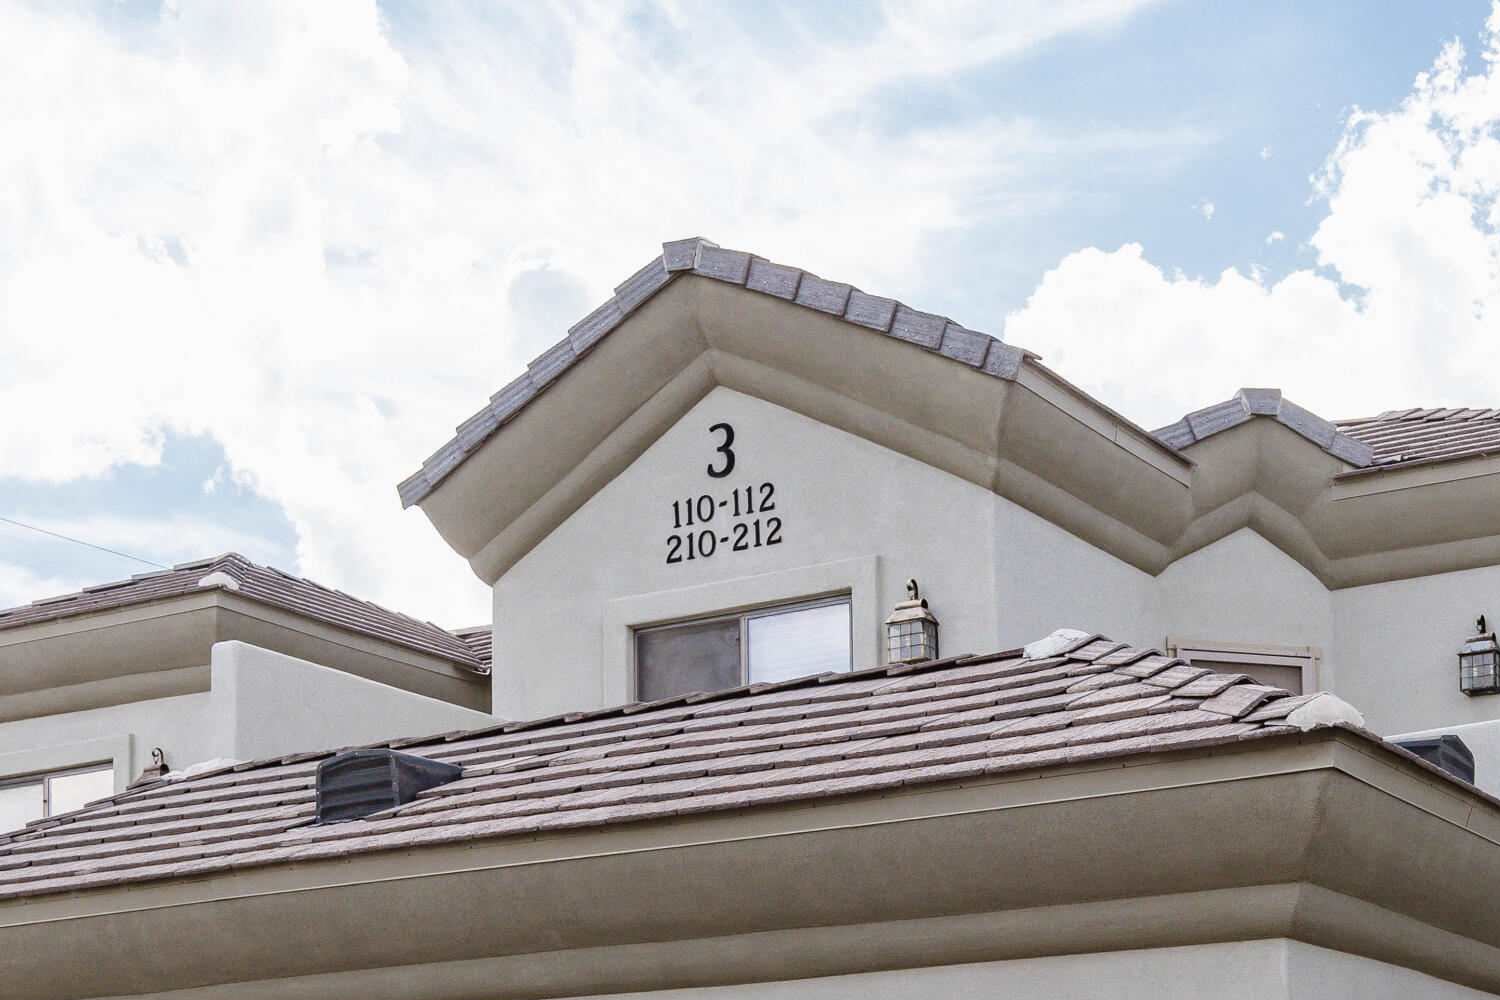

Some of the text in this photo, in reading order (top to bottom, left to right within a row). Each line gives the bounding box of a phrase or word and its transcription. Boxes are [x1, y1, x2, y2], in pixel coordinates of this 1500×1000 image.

[707, 422, 735, 478] 3
[672, 482, 775, 528] 110-112
[666, 517, 782, 564] 210-212
